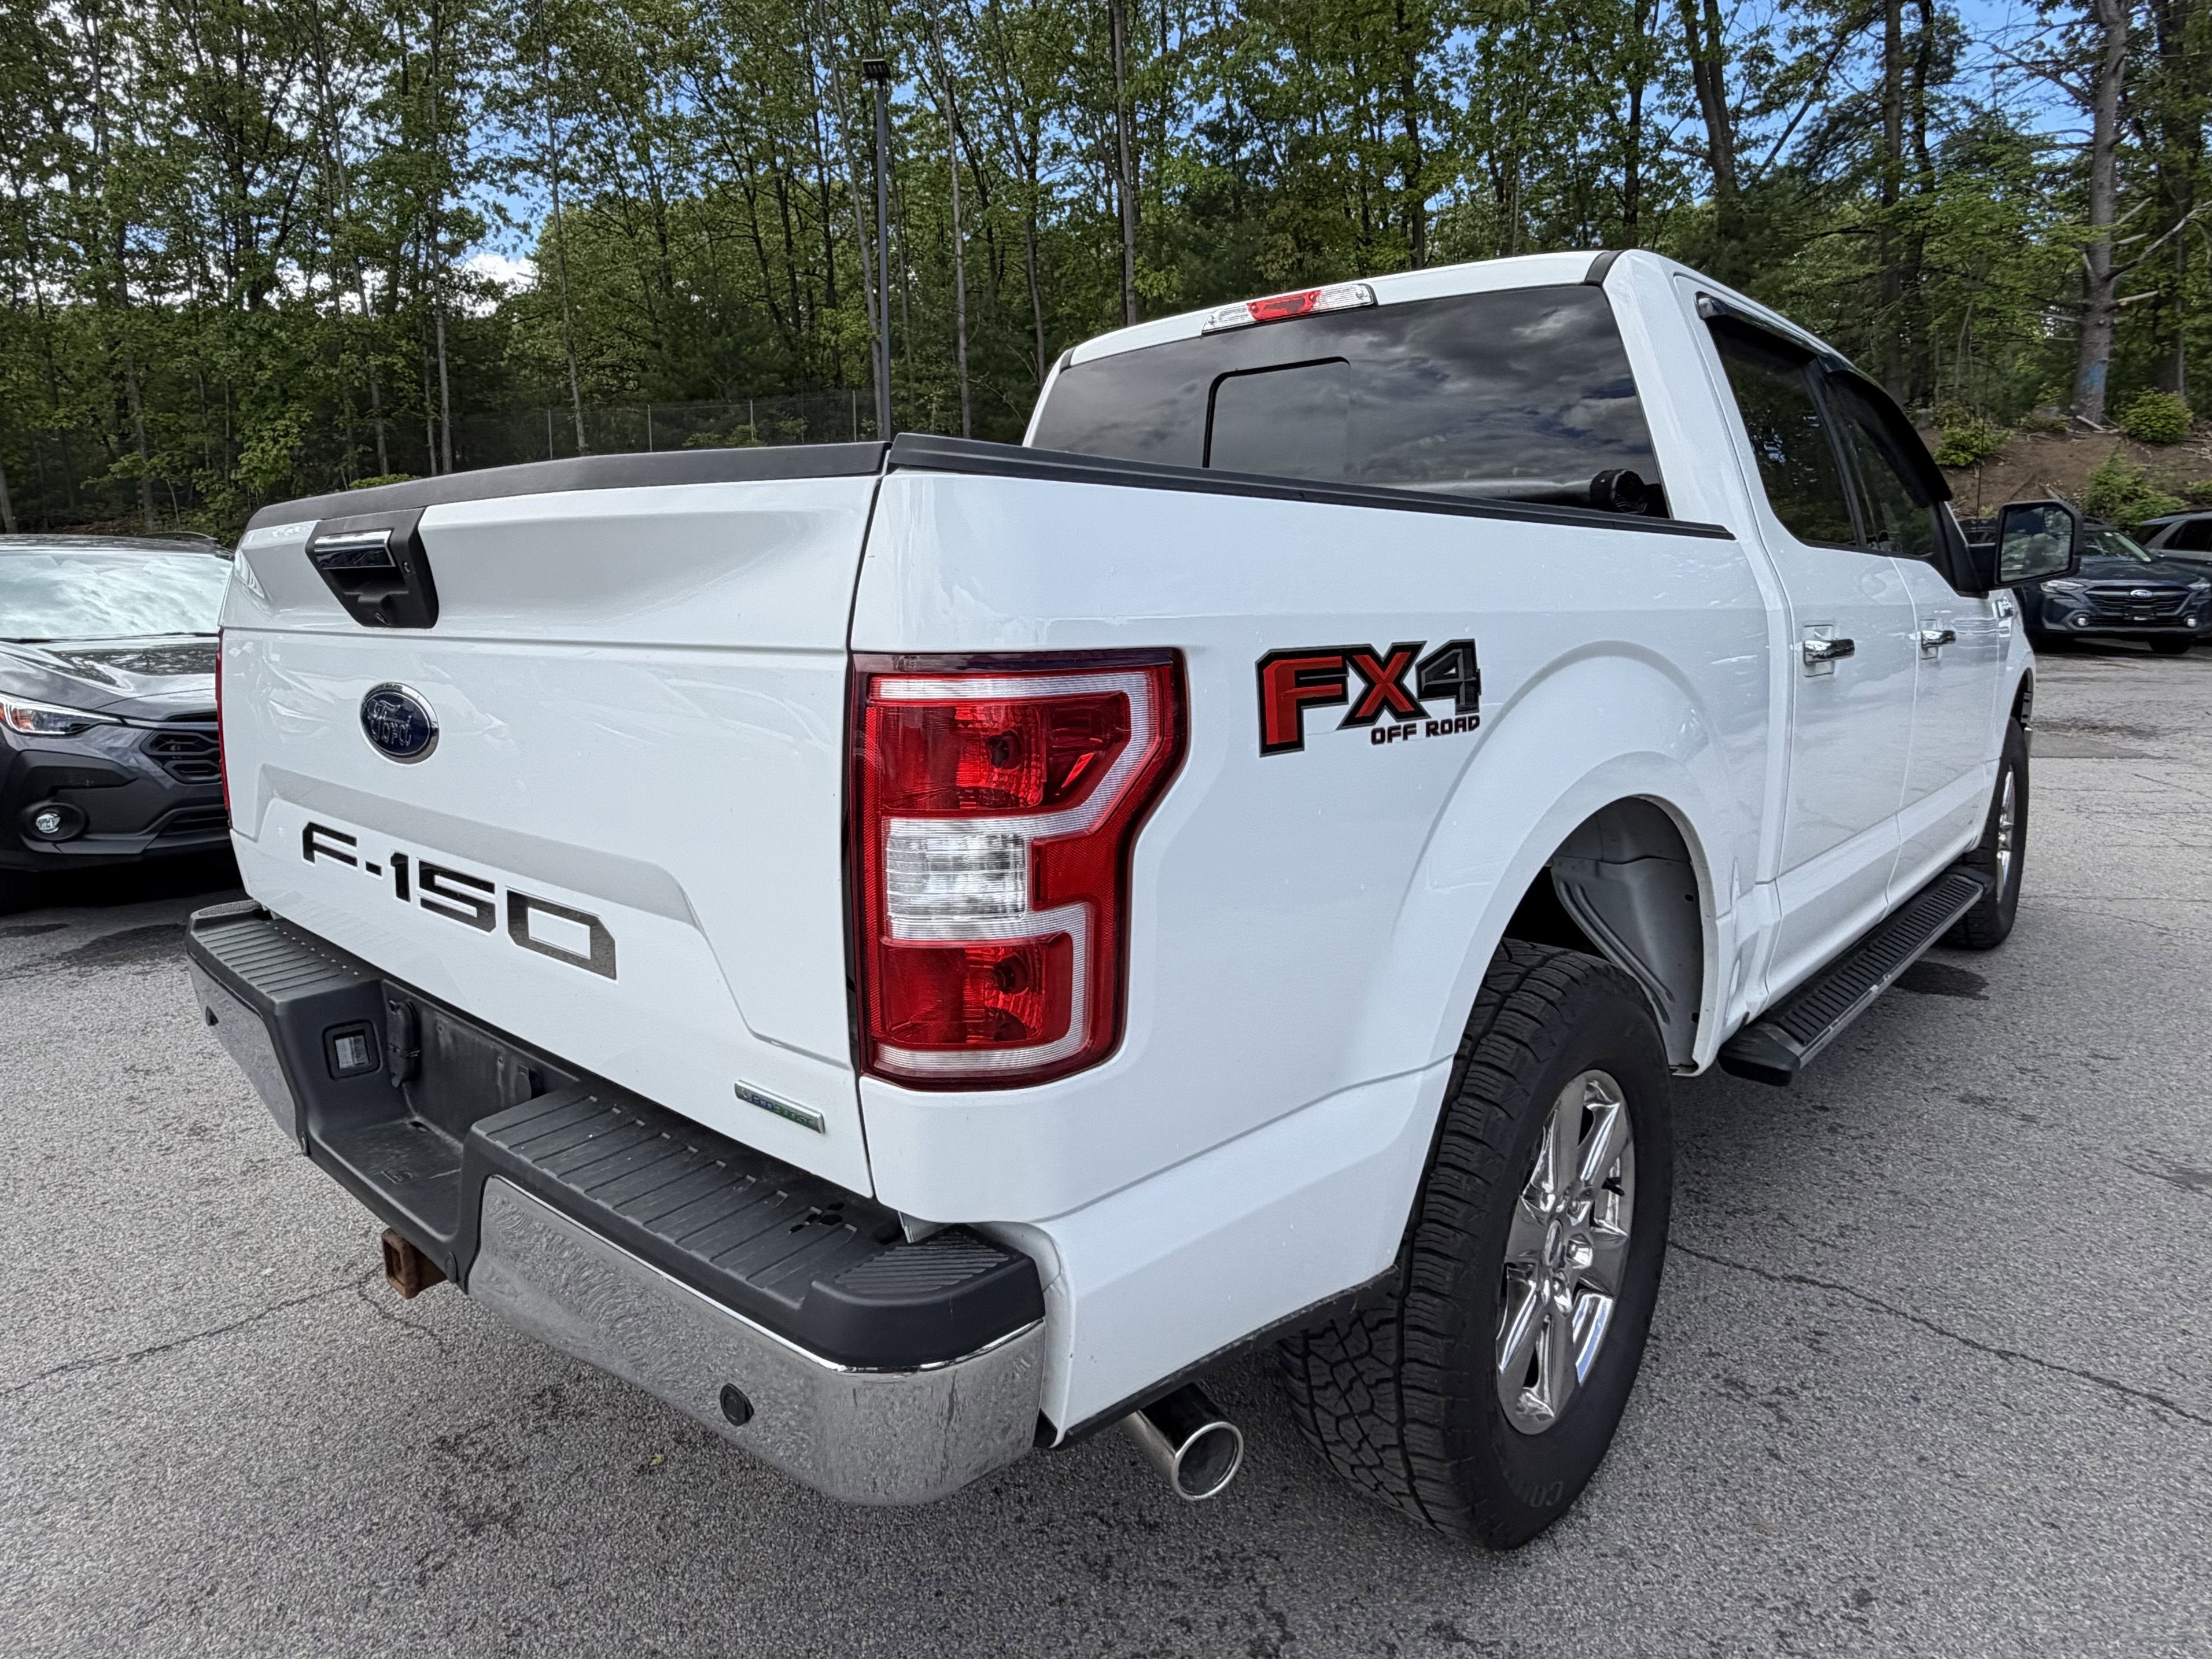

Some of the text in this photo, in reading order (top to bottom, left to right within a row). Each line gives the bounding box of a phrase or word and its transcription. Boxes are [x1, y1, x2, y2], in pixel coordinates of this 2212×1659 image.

[367, 698, 412, 747] Ford
[1255, 639, 1481, 758] FX4
[1371, 715, 1480, 746] OFF ROAD
[302, 821, 617, 980] F-150
